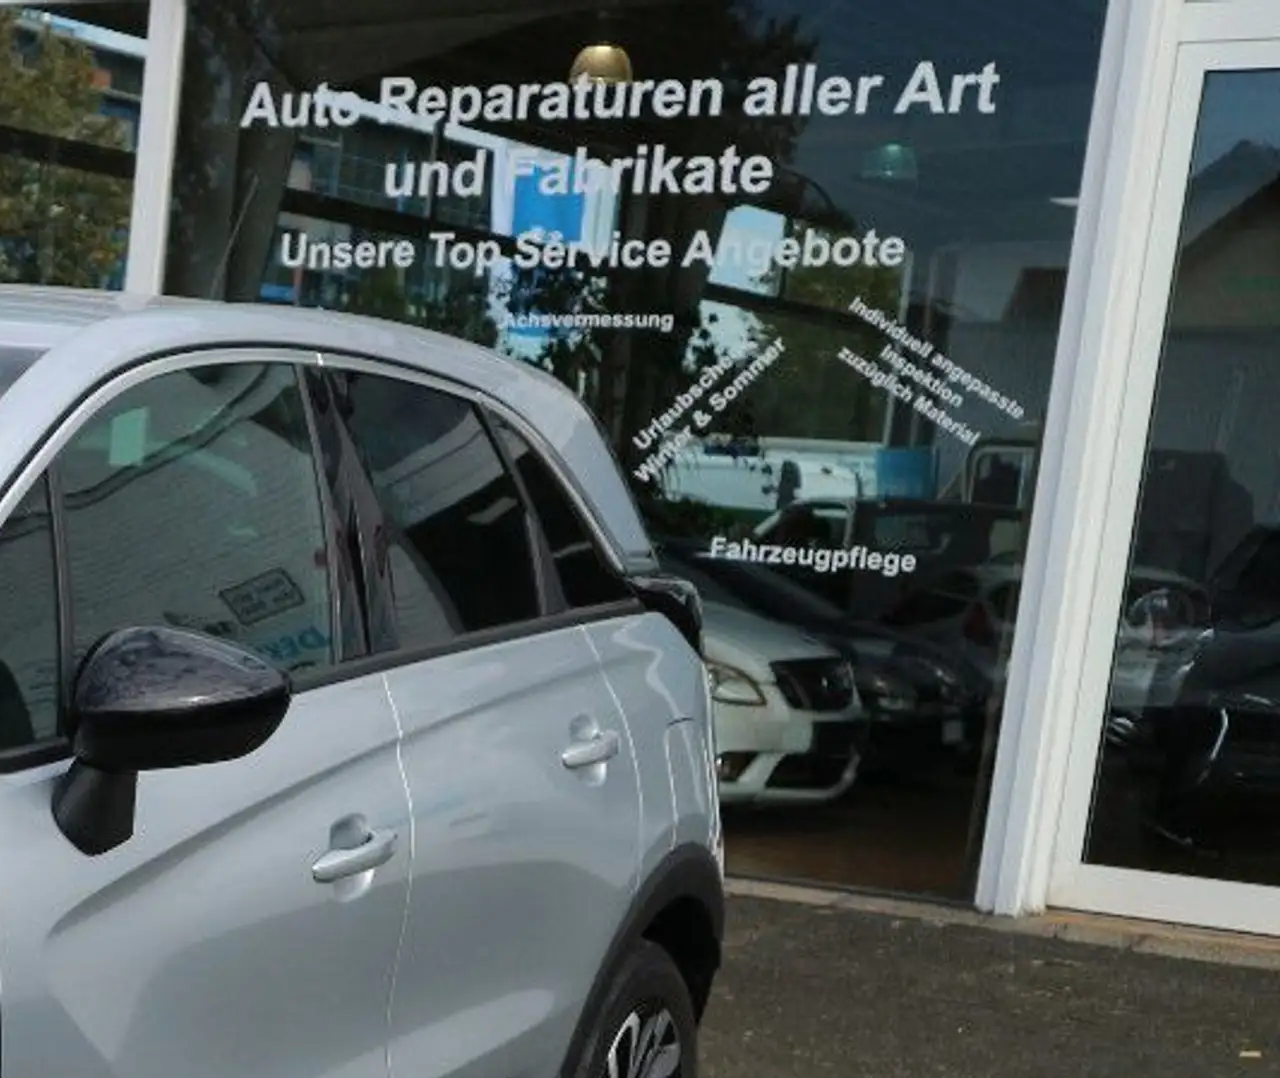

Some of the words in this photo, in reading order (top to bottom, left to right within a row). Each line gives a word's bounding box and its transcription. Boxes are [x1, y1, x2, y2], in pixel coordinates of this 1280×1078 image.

[241, 81, 361, 128] Auto
[380, 72, 724, 131] Reparaturen
[743, 63, 884, 116] aller
[893, 60, 1001, 114] Art
[385, 149, 488, 198] und
[511, 143, 774, 197] Fabrikate
[281, 232, 416, 269] Unsere
[429, 232, 502, 276] Top
[515, 230, 672, 269] Service
[680, 227, 906, 279] Angebote
[503, 311, 675, 332] Achsvermessung
[848, 296, 935, 359] Individuell
[931, 353, 1026, 420] angepasste
[878, 343, 964, 409] Inspektion
[632, 424, 694, 483] Winter
[692, 409, 713, 429] &
[708, 336, 786, 412] Sommer
[836, 345, 915, 403] zuzüglich
[912, 394, 982, 447] Material
[709, 536, 917, 577] Fahrzeugpflege
